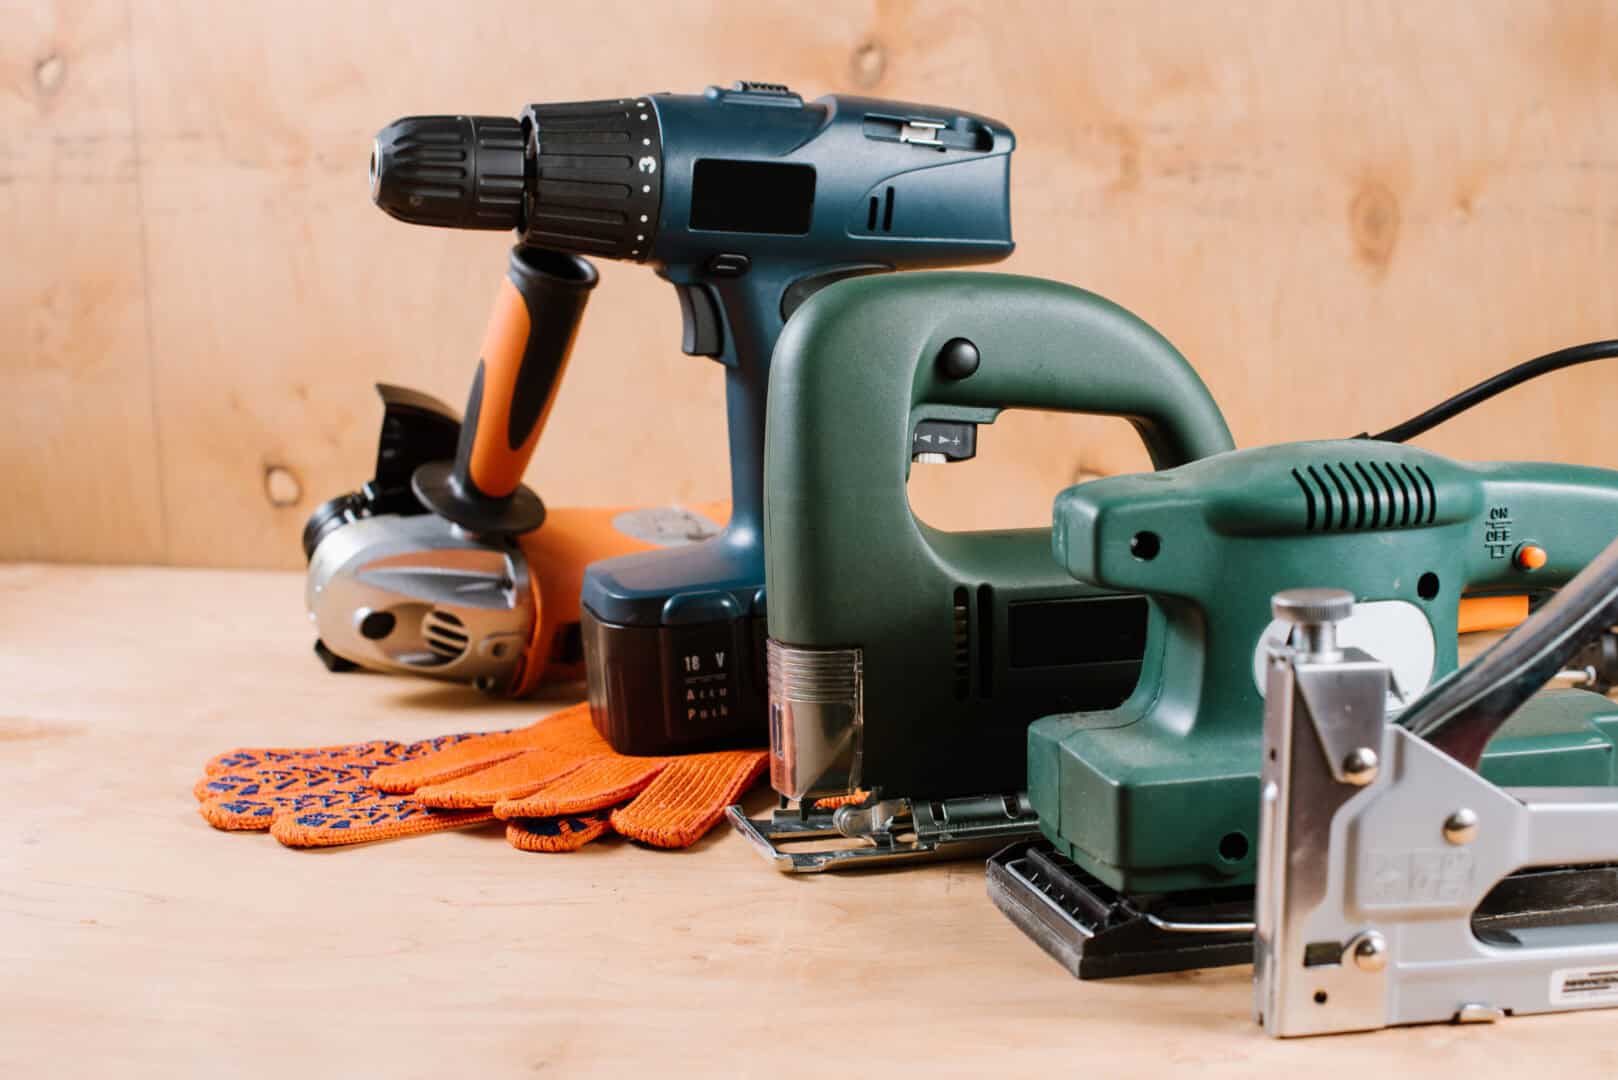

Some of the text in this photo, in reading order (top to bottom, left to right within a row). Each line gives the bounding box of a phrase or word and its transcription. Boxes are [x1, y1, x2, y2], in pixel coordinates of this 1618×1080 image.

[639, 156, 656, 174] 3
[1490, 507, 1508, 520] ON
[1486, 530, 1511, 542] OFF
[685, 652, 725, 671] 18 V
